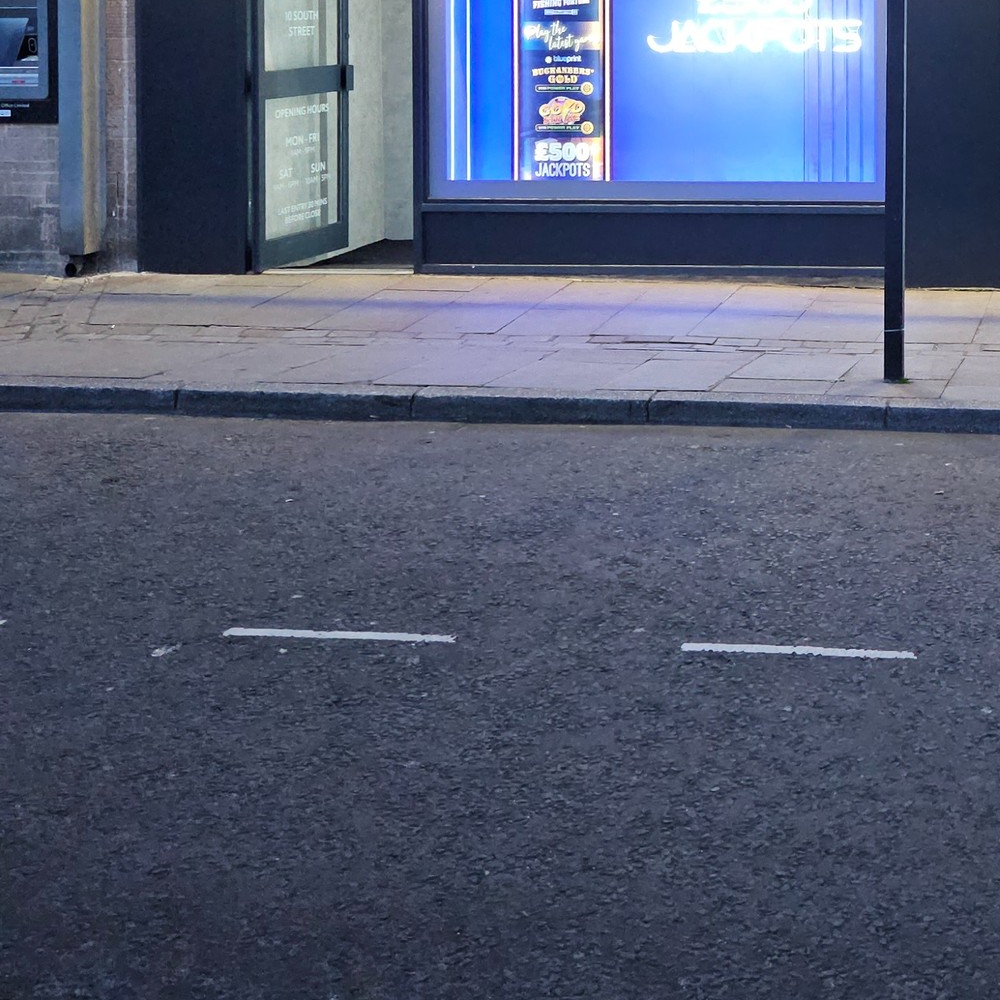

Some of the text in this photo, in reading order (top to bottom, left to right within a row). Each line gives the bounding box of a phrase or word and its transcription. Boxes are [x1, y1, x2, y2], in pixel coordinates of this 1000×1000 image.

[293, 10, 319, 21] SOUTH
[288, 26, 315, 37] STREET
[275, 103, 329, 119] OPENING HOURS
[534, 142, 590, 161] £500
[280, 161, 326, 180] SAT SUN
[534, 163, 591, 177] JACKPOTS
